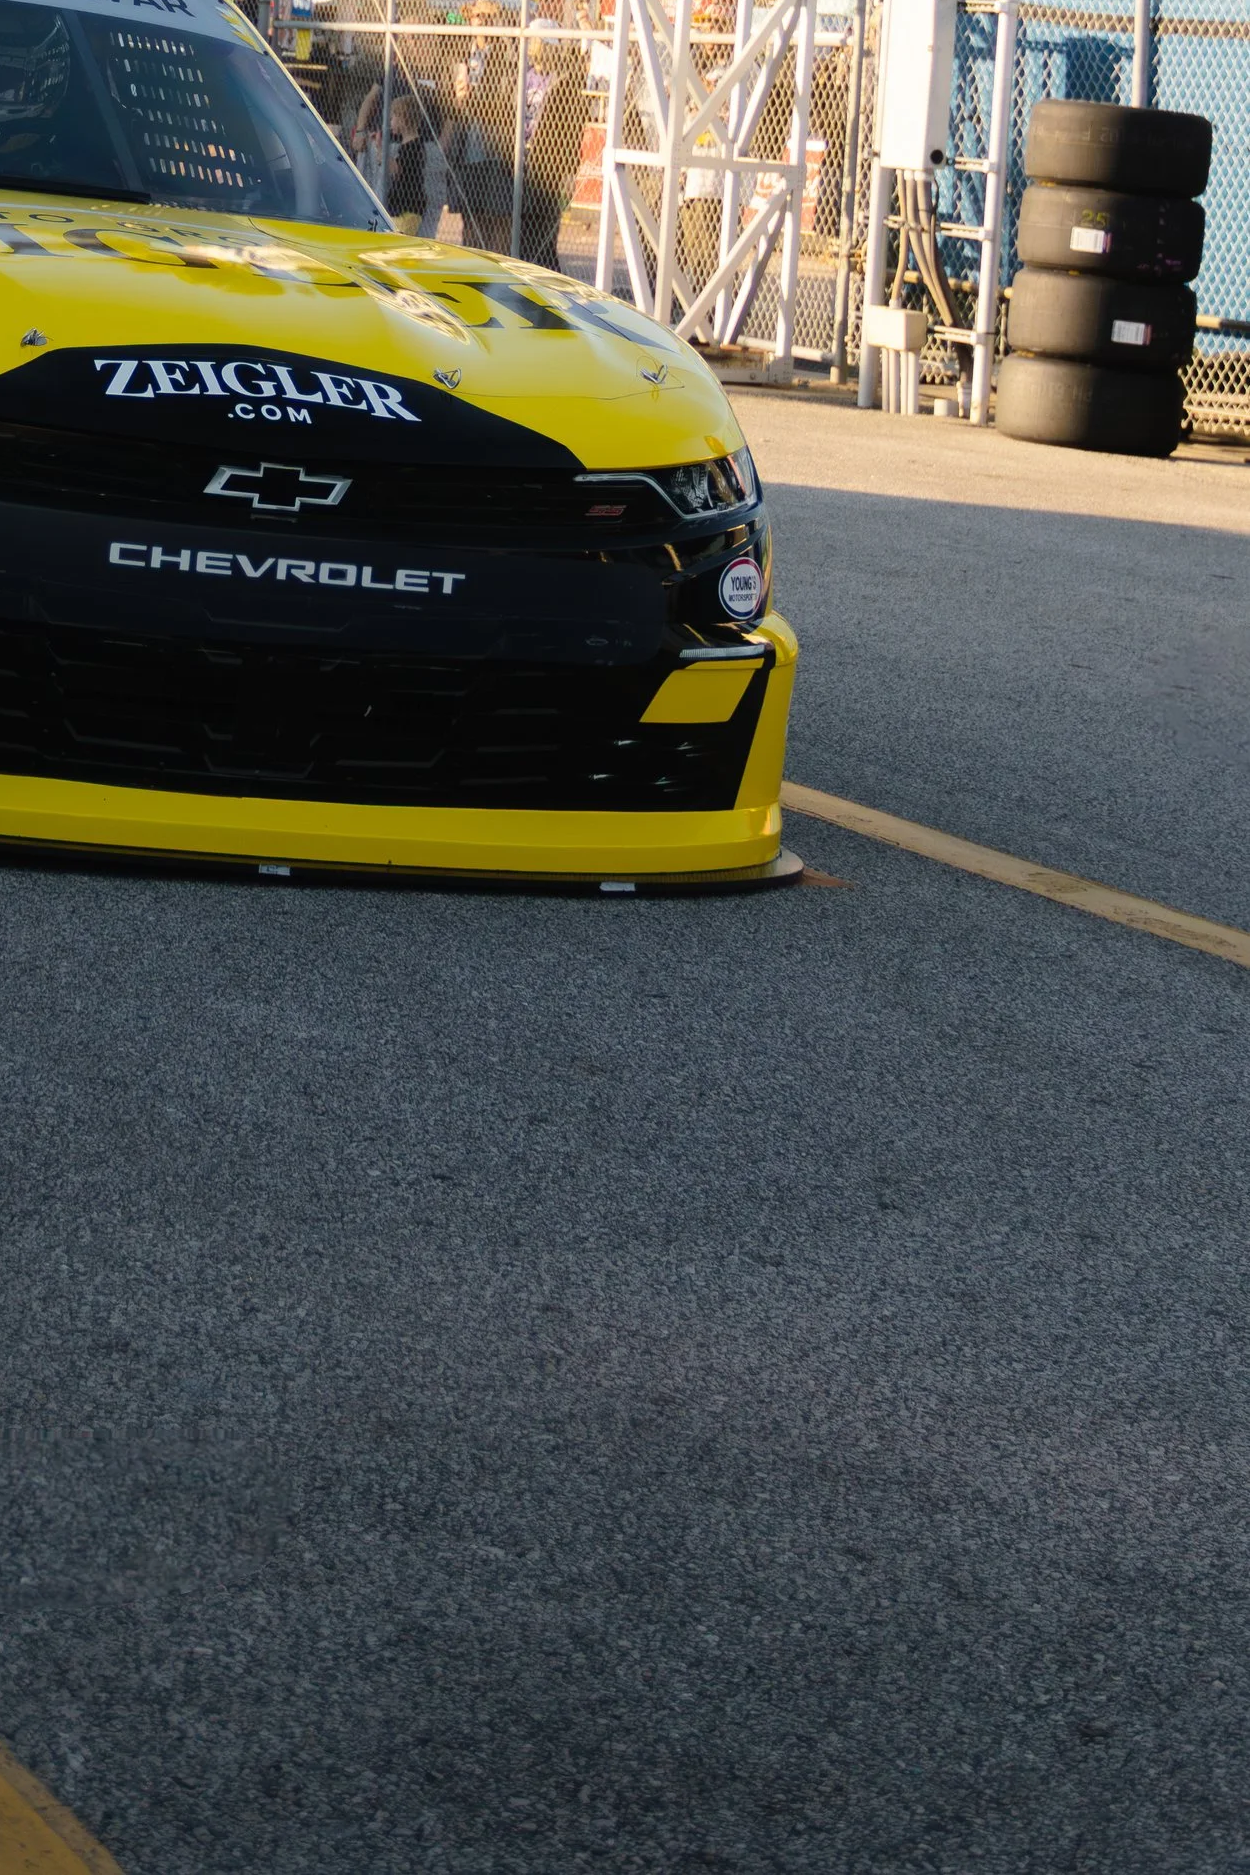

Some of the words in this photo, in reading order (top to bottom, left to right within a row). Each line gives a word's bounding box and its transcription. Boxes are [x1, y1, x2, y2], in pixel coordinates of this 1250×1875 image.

[94, 358, 422, 422] ZEIGLER
[227, 403, 313, 424] .COM
[109, 542, 466, 594] CHEVROLET
[730, 576, 757, 591] YOUNG'S
